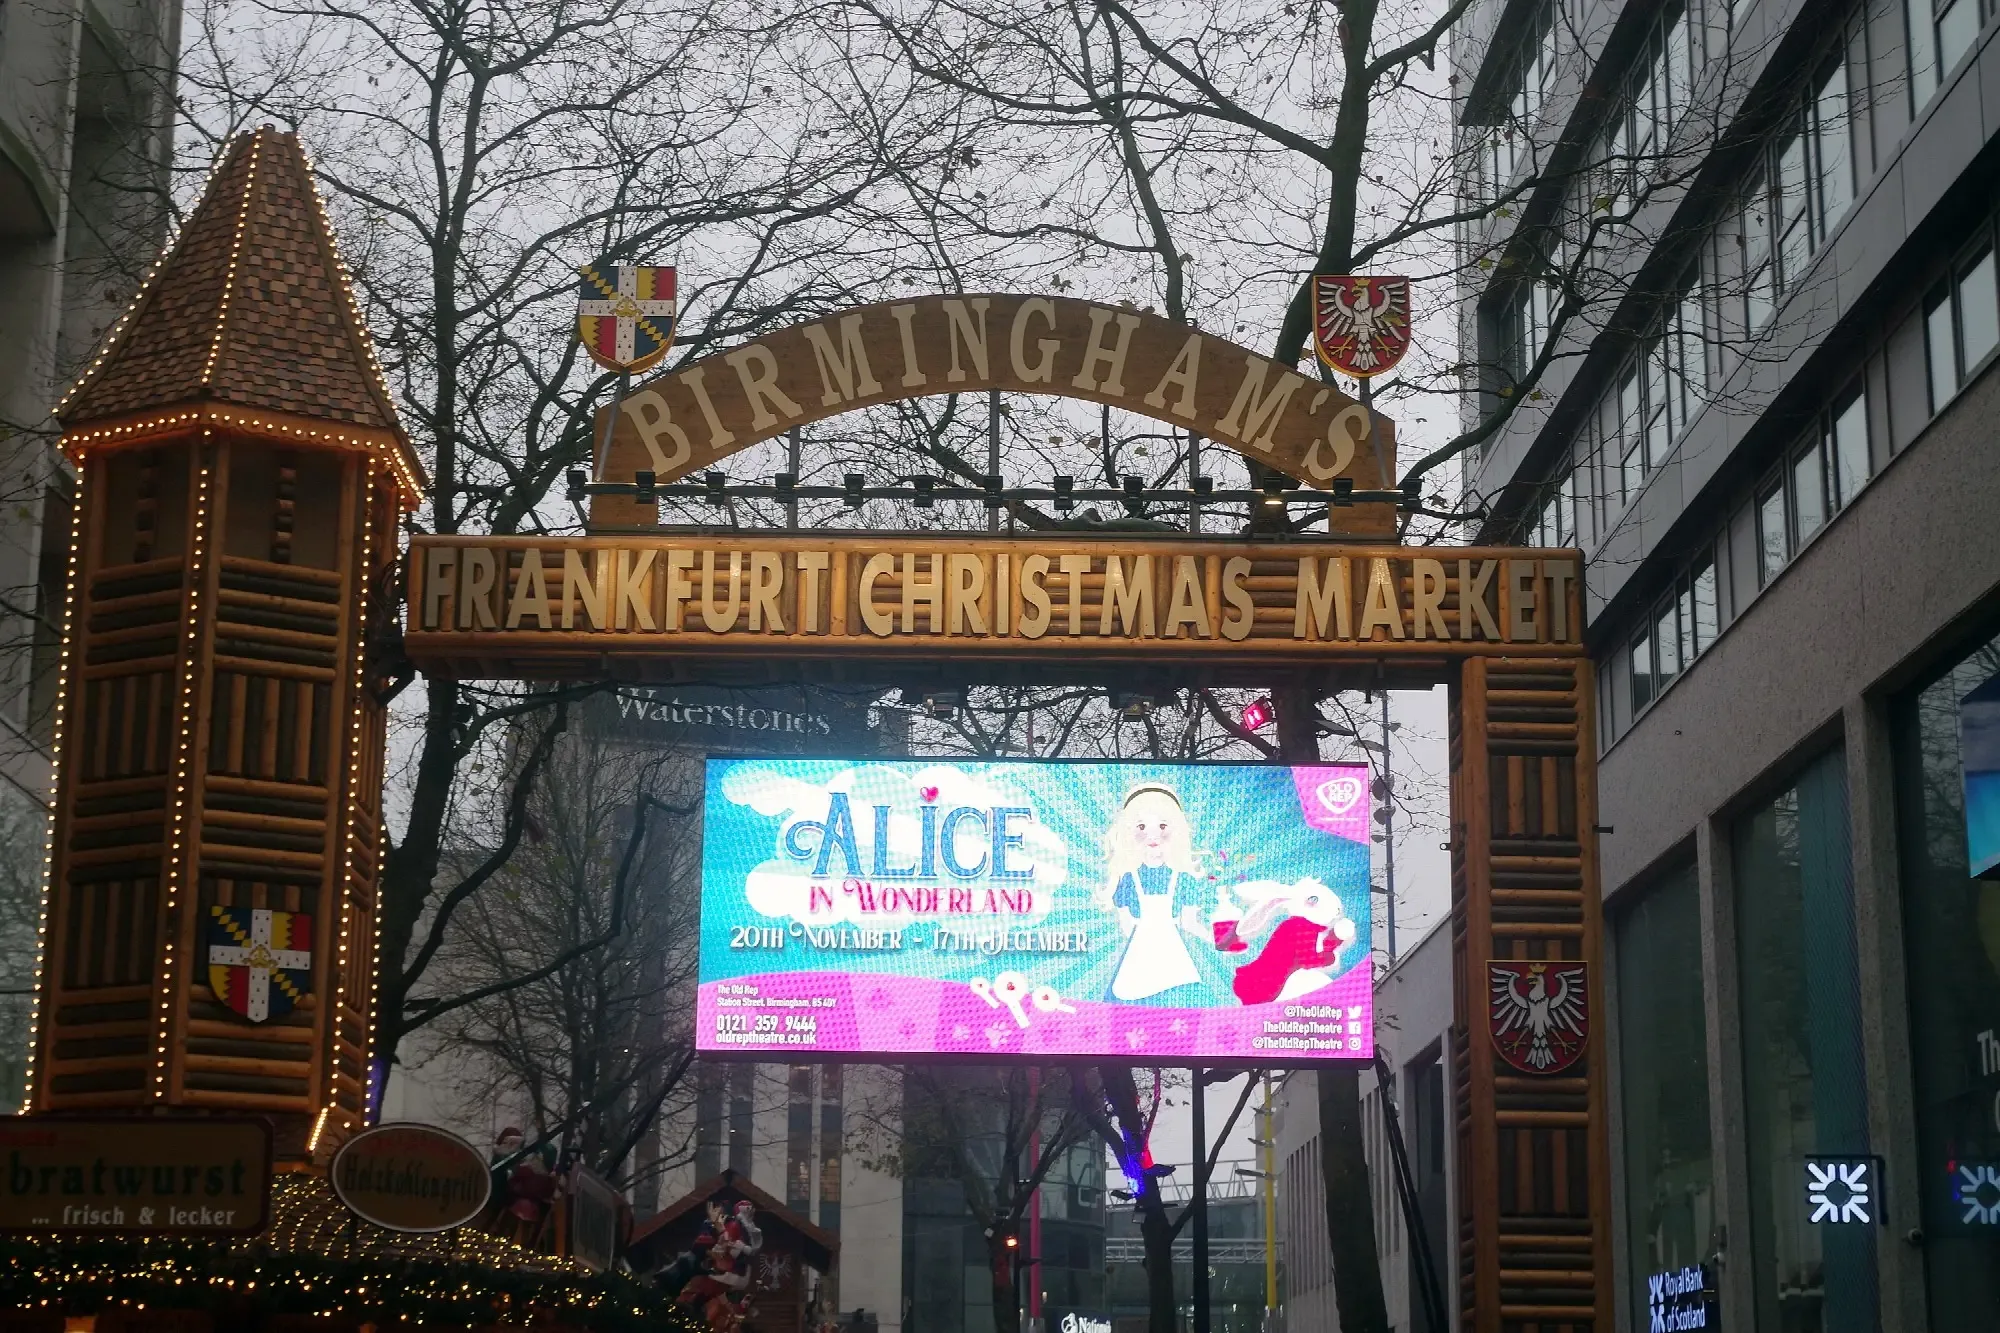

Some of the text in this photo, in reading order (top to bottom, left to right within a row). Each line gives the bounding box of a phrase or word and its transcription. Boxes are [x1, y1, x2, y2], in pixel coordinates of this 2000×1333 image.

[621, 297, 1371, 480] BIRMINGHAM'S
[423, 547, 1574, 642] FRANKFURT CHRISTMAS MARKET
[616, 687, 831, 735] Waterstones
[785, 787, 1036, 880] ALICE
[809, 879, 1034, 915] IN WONDERLAND
[729, 925, 785, 949] 20TH
[788, 922, 903, 950] NOVEMBER
[933, 931, 976, 951] 17TH
[979, 930, 1089, 955] DECEMBER
[717, 984, 759, 997] The Old Rep
[716, 1014, 817, 1032] 0121 359 9444
[1263, 1021, 1343, 1036] TheOldRepTheatre
[1284, 1006, 1343, 1021] @TheOldRep
[716, 1029, 817, 1046] oldreptheatre.co.uk
[1252, 1037, 1343, 1052] @TheOldRepTheatre
[0, 1150, 247, 1197] bratwurst
[62, 1204, 125, 1226] frisch
[137, 1206, 156, 1226] &
[169, 1205, 237, 1226] lecker
[1665, 1263, 1704, 1303] Royal Bank
[1667, 1300, 1706, 1333] of Scotland
